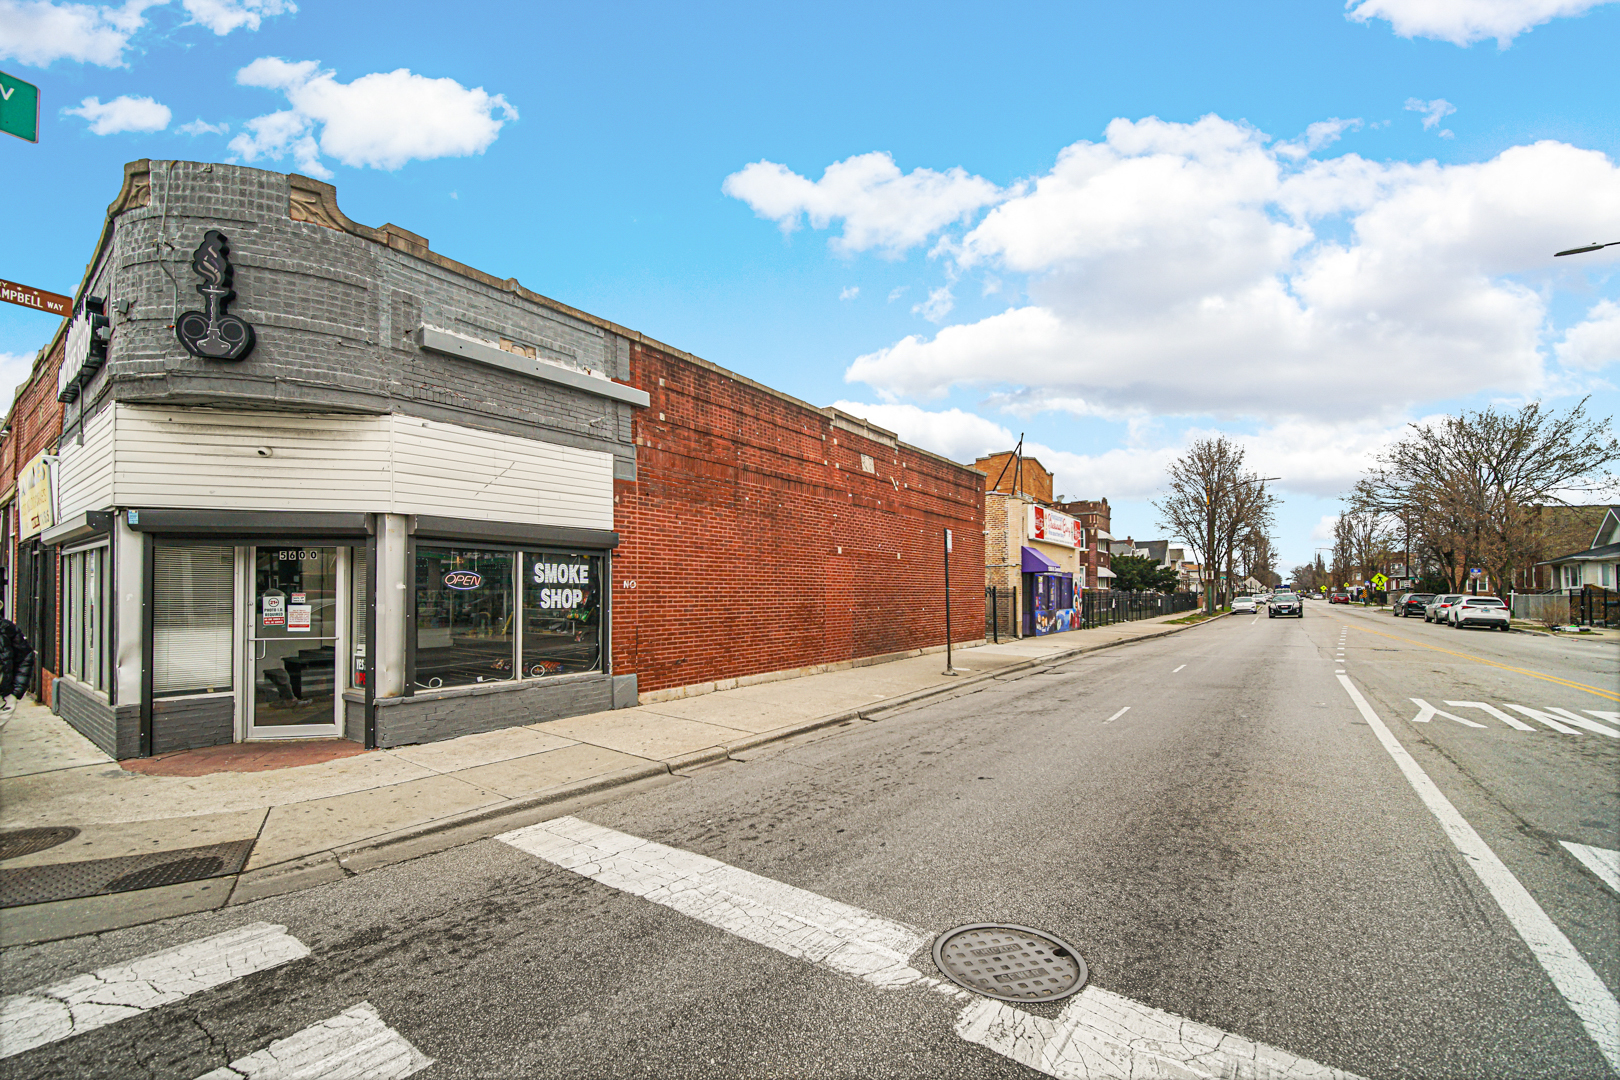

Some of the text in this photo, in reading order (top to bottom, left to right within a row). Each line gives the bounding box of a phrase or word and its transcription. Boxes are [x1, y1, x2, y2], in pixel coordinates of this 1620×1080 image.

[0, 287, 64, 312] MPBELL WAY
[280, 551, 317, 560] 5600
[444, 574, 482, 587] OPEN
[534, 562, 589, 584] SMOKE
[623, 580, 637, 589] NO
[540, 588, 583, 609] SHOP
[1409, 697, 1620, 738] NLY
[1001, 969, 1041, 981] SEWER
